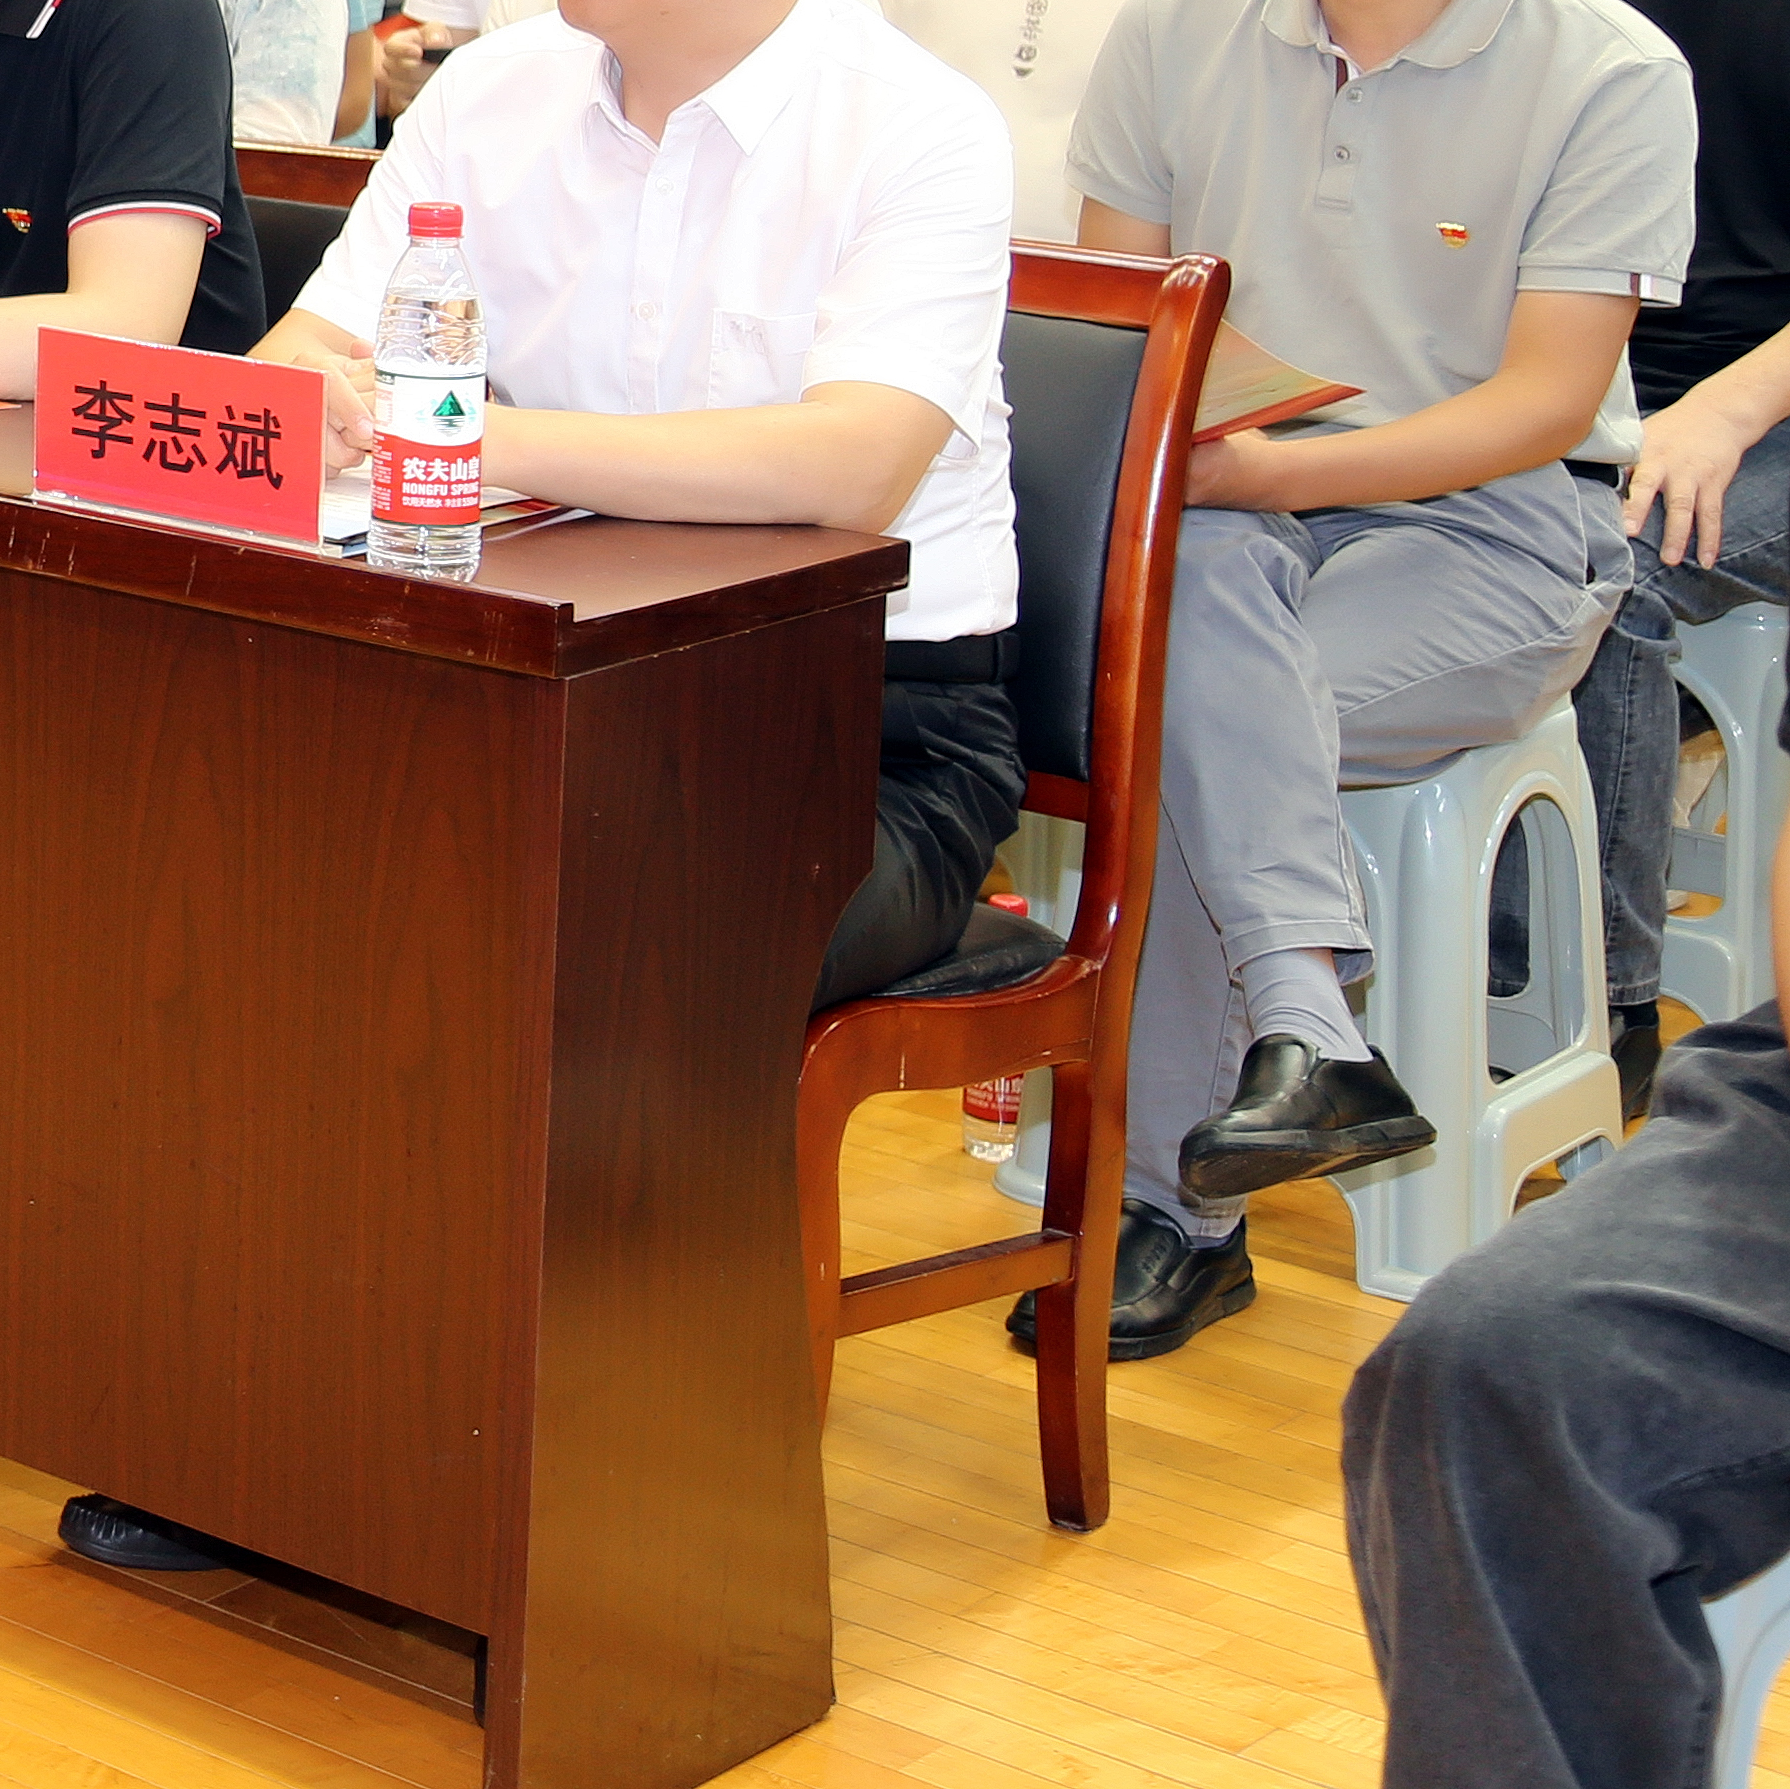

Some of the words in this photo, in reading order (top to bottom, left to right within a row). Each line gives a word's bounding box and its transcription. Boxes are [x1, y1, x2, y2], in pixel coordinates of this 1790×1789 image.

[71, 379, 283, 490] 李志斌
[402, 456, 480, 482] 农夫山泉
[402, 481, 448, 496] NONGFU
